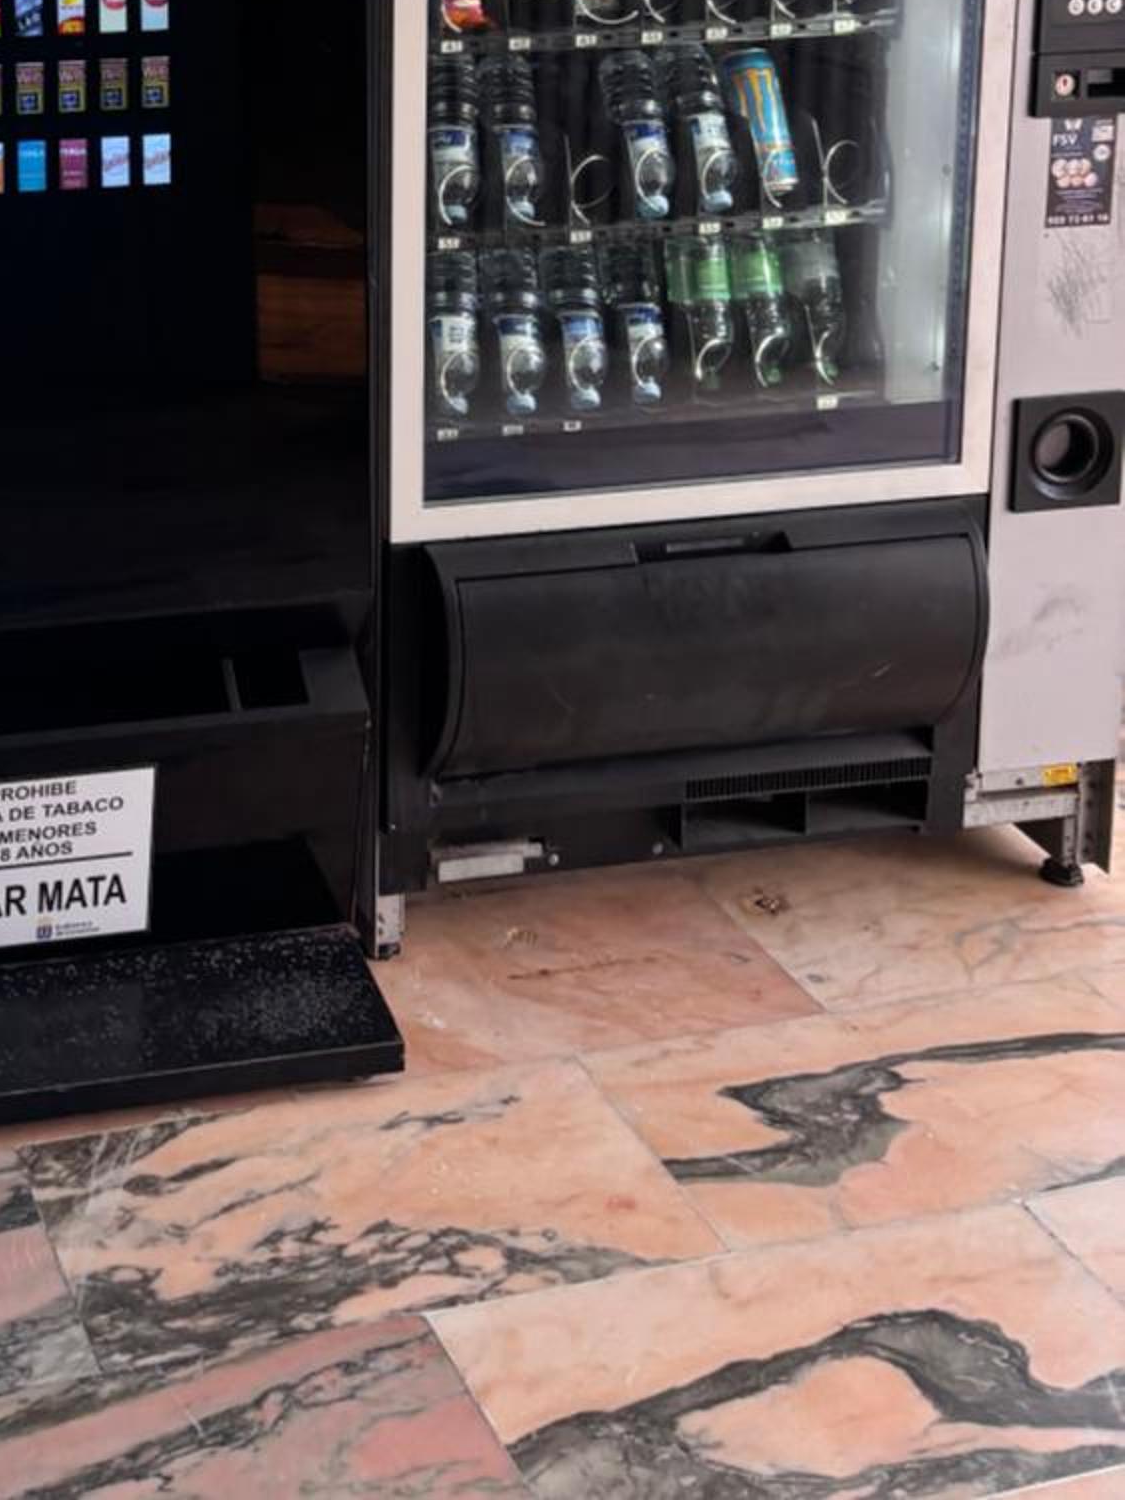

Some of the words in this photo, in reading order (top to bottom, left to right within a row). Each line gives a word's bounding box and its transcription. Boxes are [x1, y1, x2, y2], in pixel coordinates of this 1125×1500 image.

[9, 806, 35, 821] DE
[42, 796, 124, 818] TABACO
[15, 841, 73, 861] AÑOS
[38, 873, 127, 914] MATA
